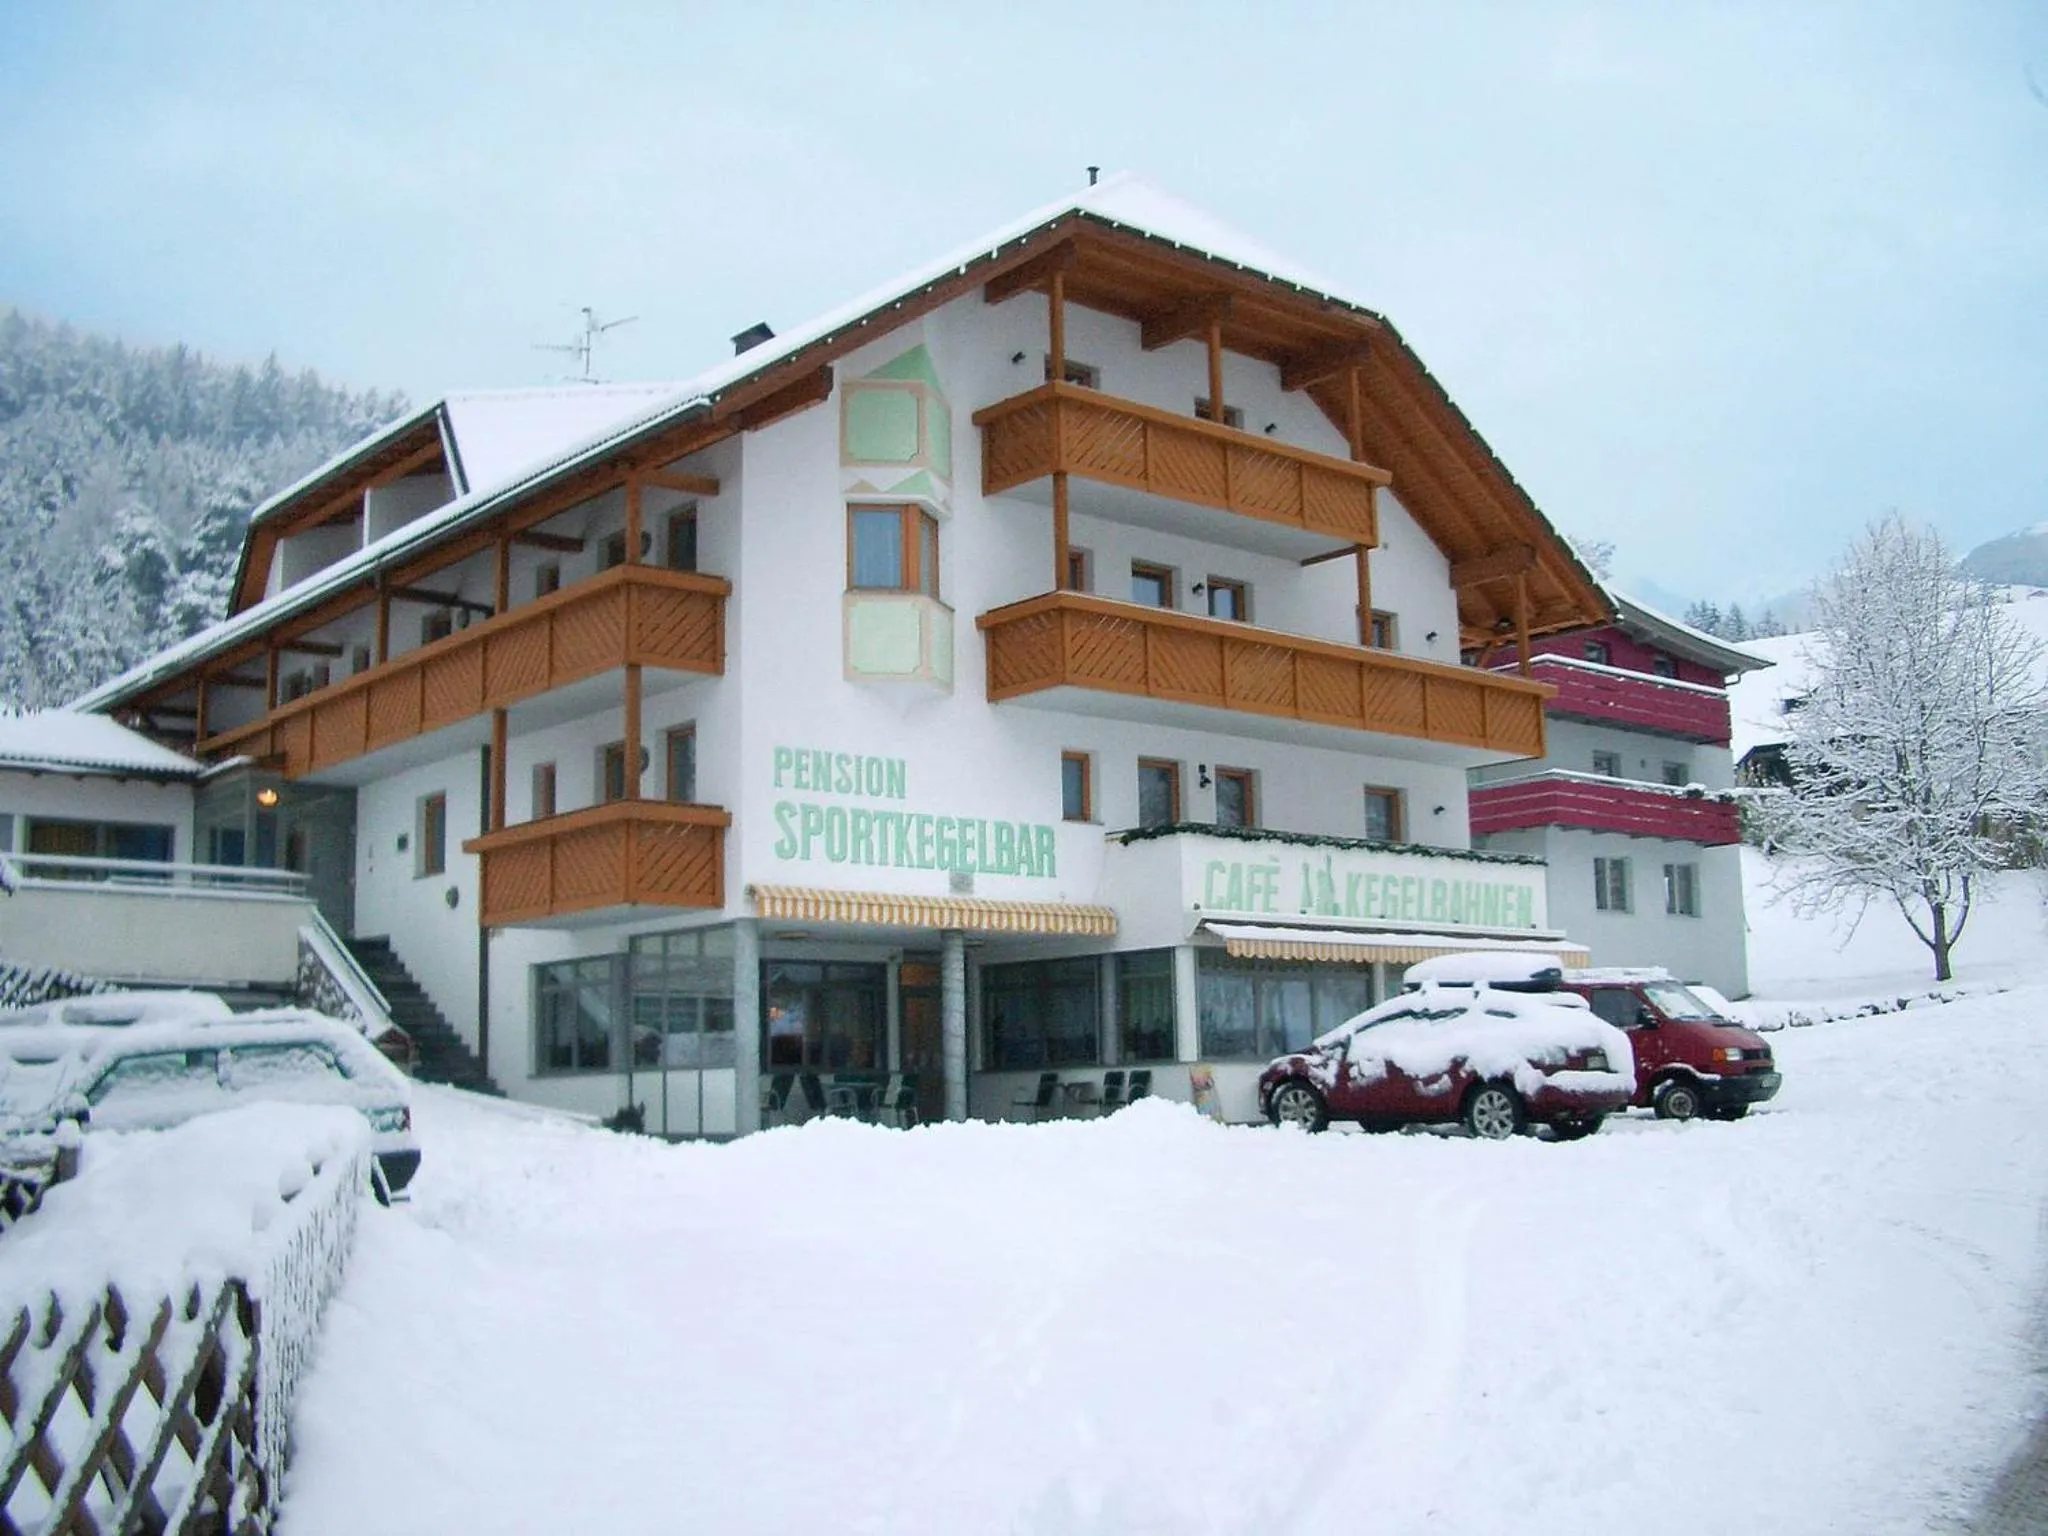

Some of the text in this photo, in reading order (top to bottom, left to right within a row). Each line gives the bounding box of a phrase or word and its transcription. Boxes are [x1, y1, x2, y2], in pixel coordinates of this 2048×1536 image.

[773, 746, 906, 799] PENSION
[774, 801, 1056, 877] SPORTKEGELBAR
[1346, 872, 1532, 929] KEGELBAHNEN
